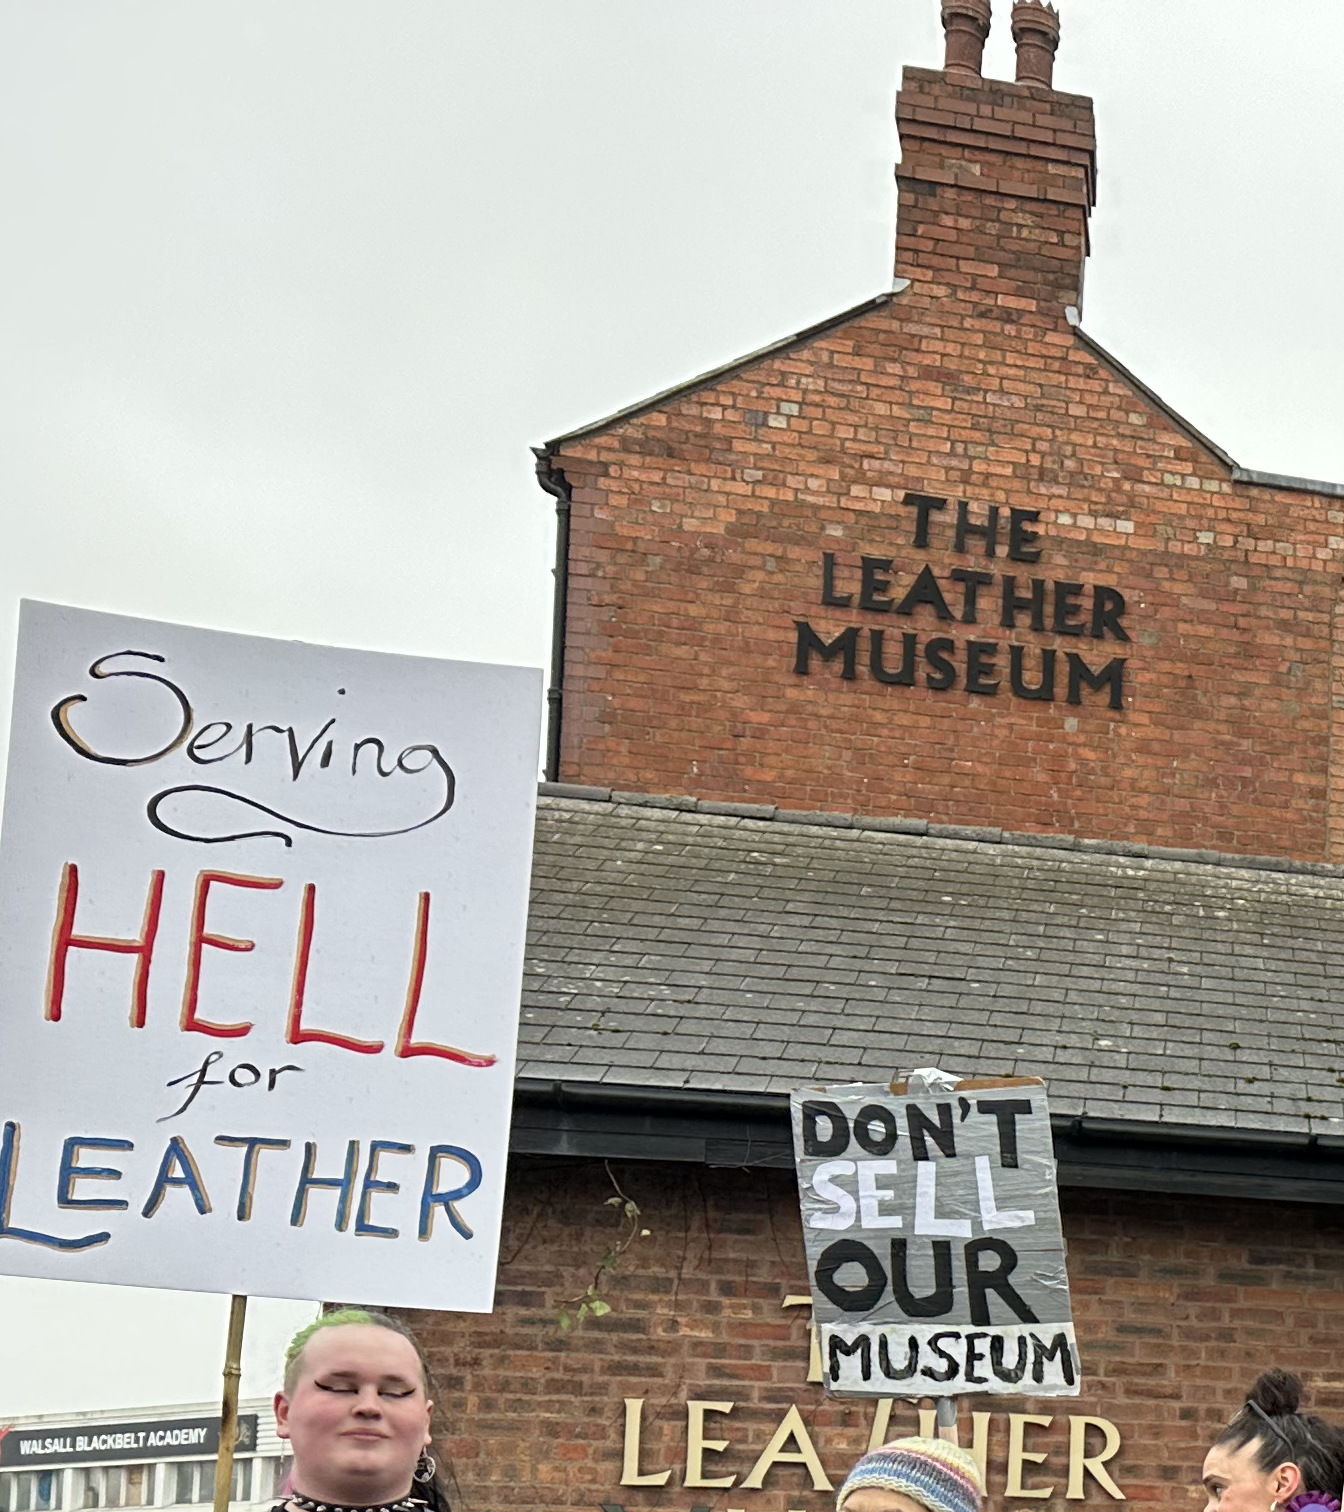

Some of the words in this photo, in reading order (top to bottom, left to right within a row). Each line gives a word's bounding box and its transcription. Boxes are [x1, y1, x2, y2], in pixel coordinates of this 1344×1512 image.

[901, 492, 1044, 563] THE
[821, 551, 1132, 642] LEATHER
[793, 620, 1130, 710] MUSEUM
[51, 649, 456, 847] Serving
[44, 862, 497, 1068] HELL
[155, 1050, 306, 1122] for
[803, 1096, 1034, 1168] DON'T
[0, 1120, 484, 1251] LEATHER
[807, 1156, 1036, 1237] SELL
[814, 1237, 1041, 1326] OUR
[827, 1330, 1076, 1386] MUSEUM
[20, 1438, 73, 1455] WALSALL
[76, 1432, 145, 1451] BLACKBELT
[148, 1428, 207, 1447] ACADEMY
[620, 1398, 1127, 1500] LEAHER
